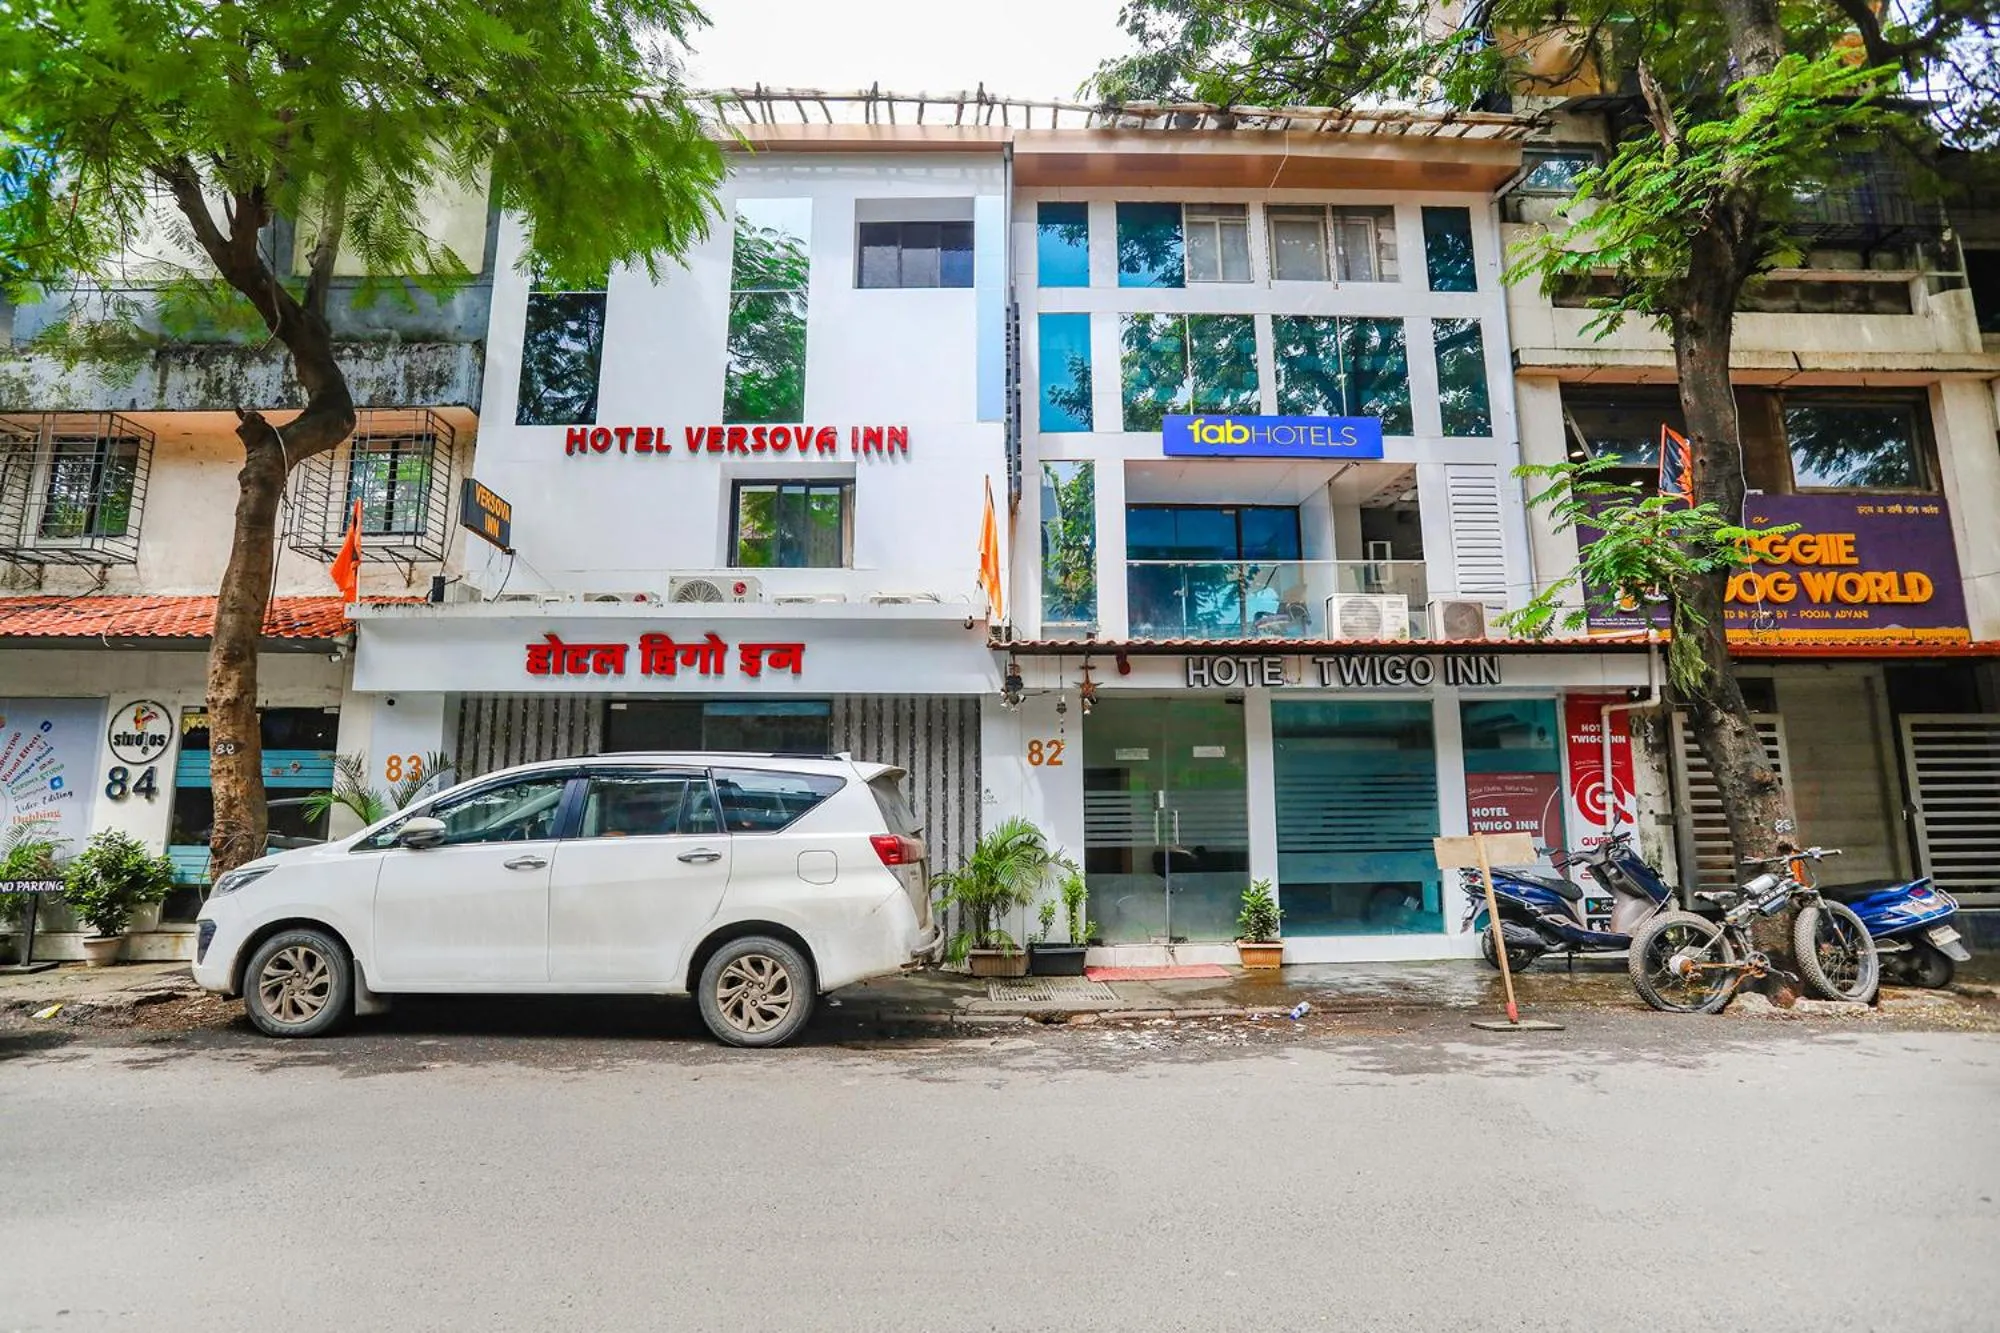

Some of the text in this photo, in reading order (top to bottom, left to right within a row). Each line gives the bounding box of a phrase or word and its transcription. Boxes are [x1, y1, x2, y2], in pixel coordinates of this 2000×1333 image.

[565, 426, 909, 456] HOTEL VERSOVA INN
[475, 482, 510, 523] VERSOVA
[485, 512, 500, 537] INN
[1800, 571, 1934, 604] WORLD
[1800, 609, 1832, 619] POOJA
[526, 632, 629, 676] होटल
[738, 643, 806, 679] इन
[1313, 656, 1435, 687] TWIGO
[1445, 655, 1501, 687] INN
[1027, 738, 1065, 767] 82
[1611, 735, 1627, 743] NN
[385, 754, 423, 783] 83
[105, 766, 157, 801] 84
[42, 789, 73, 806] Editing
[13, 809, 62, 825] Dubbing
[1471, 807, 1510, 818] HOTEL
[1472, 820, 1540, 832] TWIGO INN
[0, 880, 65, 893] NO PARKING
